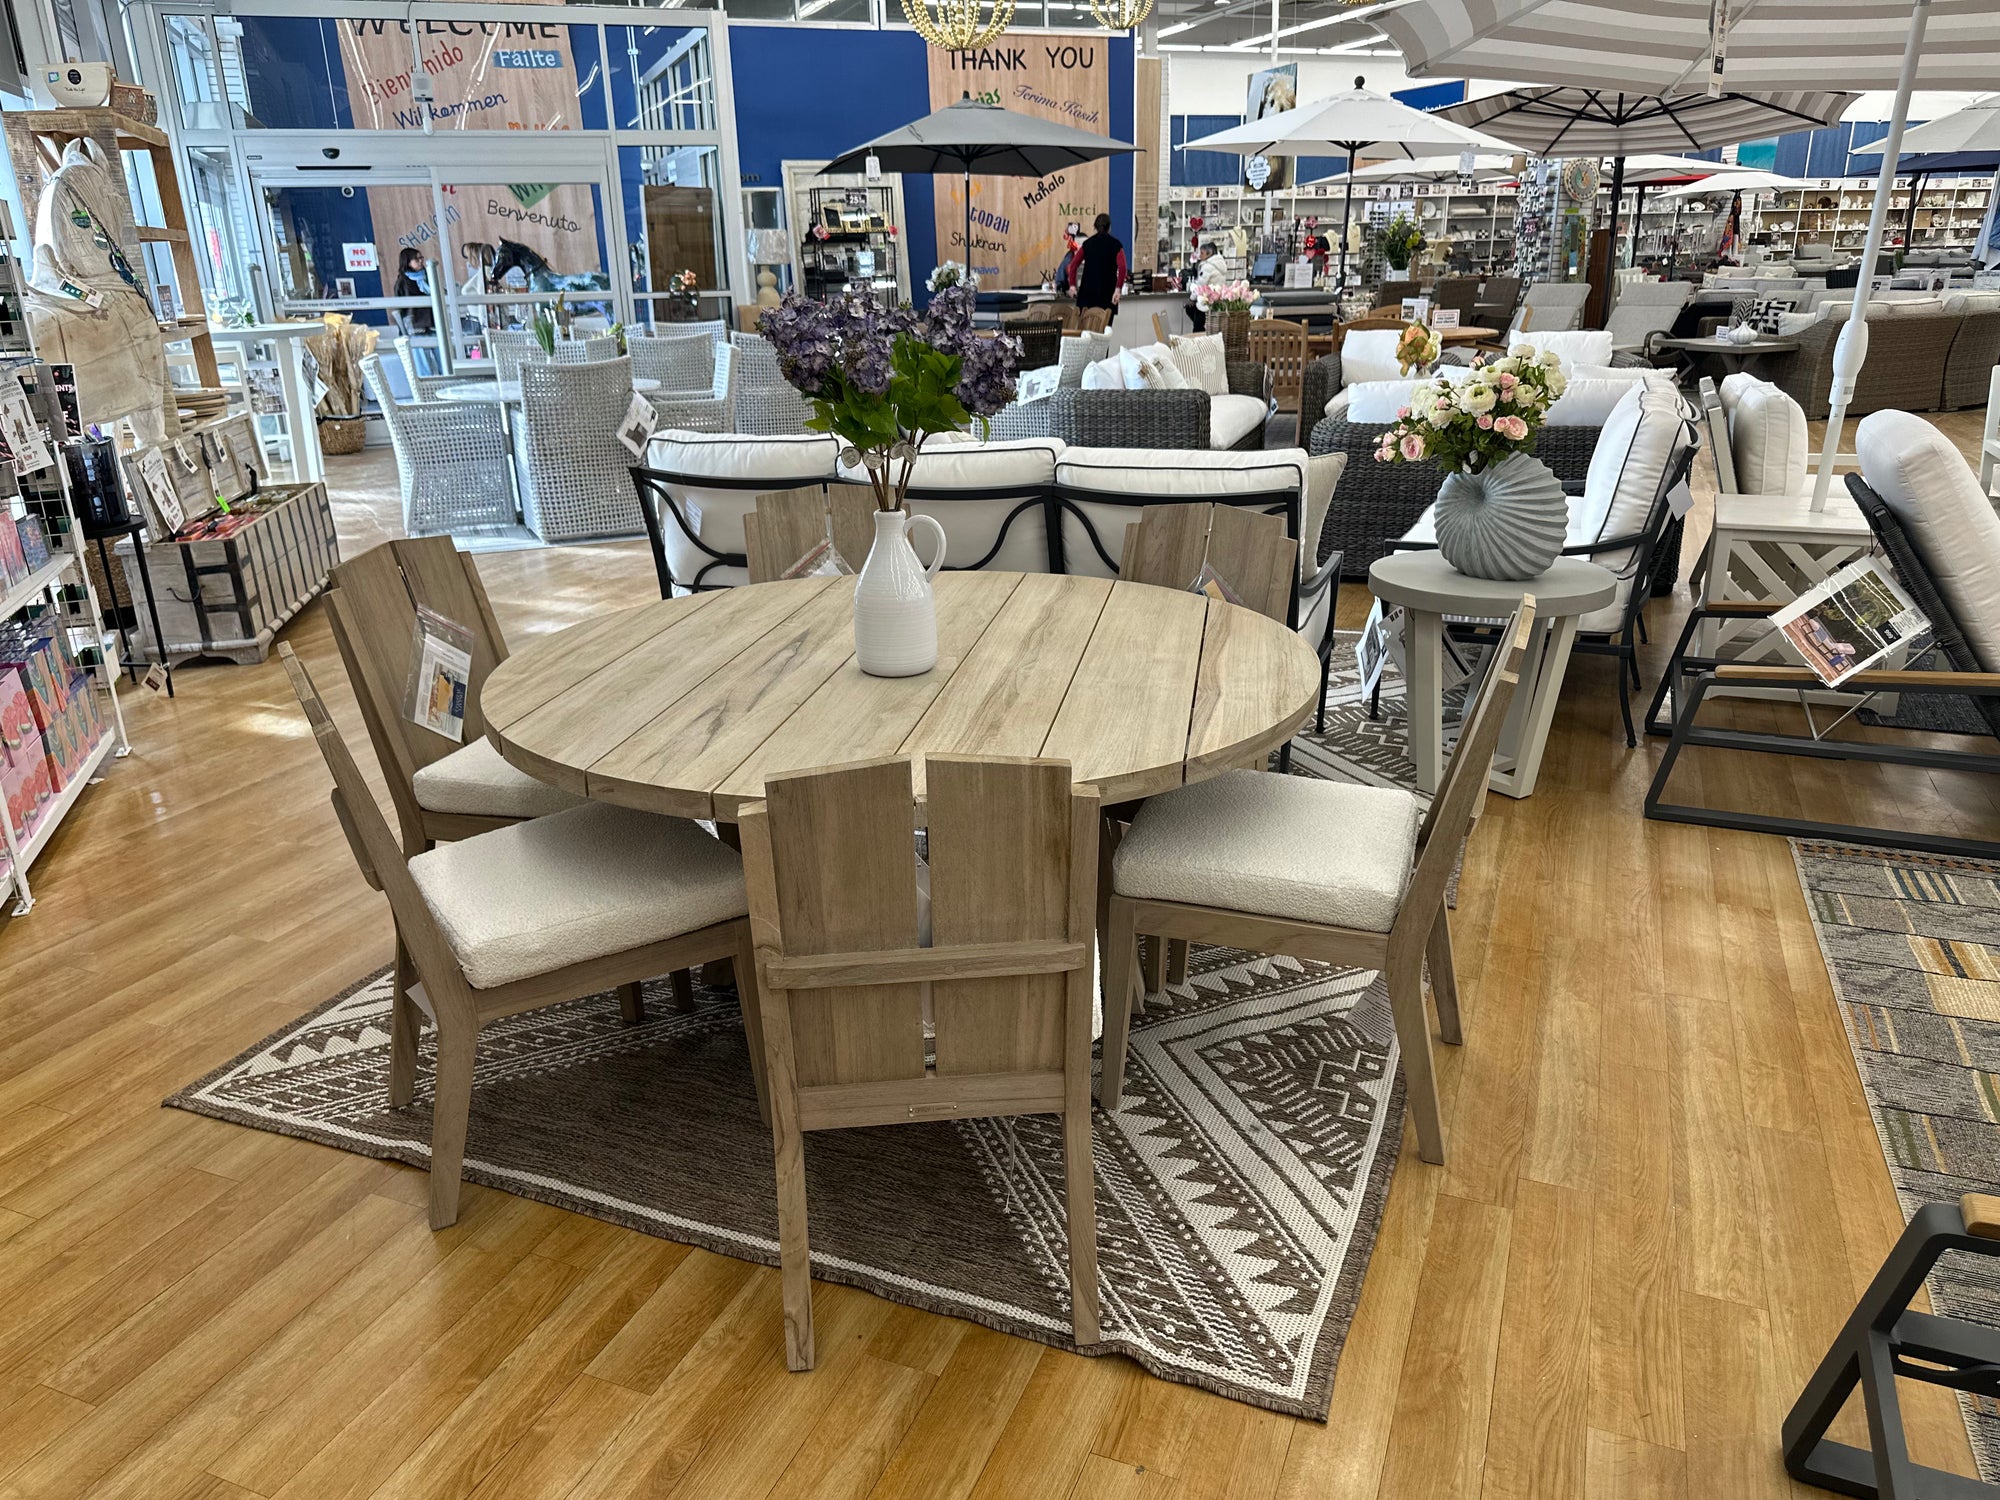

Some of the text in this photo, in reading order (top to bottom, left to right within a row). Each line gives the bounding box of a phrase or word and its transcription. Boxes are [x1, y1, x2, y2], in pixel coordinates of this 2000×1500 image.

[499, 48, 556, 67] Fáilte
[946, 46, 1094, 71] THANK YOU
[362, 40, 463, 105] Biennido
[392, 93, 508, 129] Wilkommen
[1013, 84, 1099, 125] Terima Kasih
[1023, 174, 1066, 209] Mahalo
[487, 199, 581, 232] Benvenuto
[1059, 203, 1097, 216] Merci
[352, 248, 366, 256] NO
[950, 231, 1007, 253] Shukran
